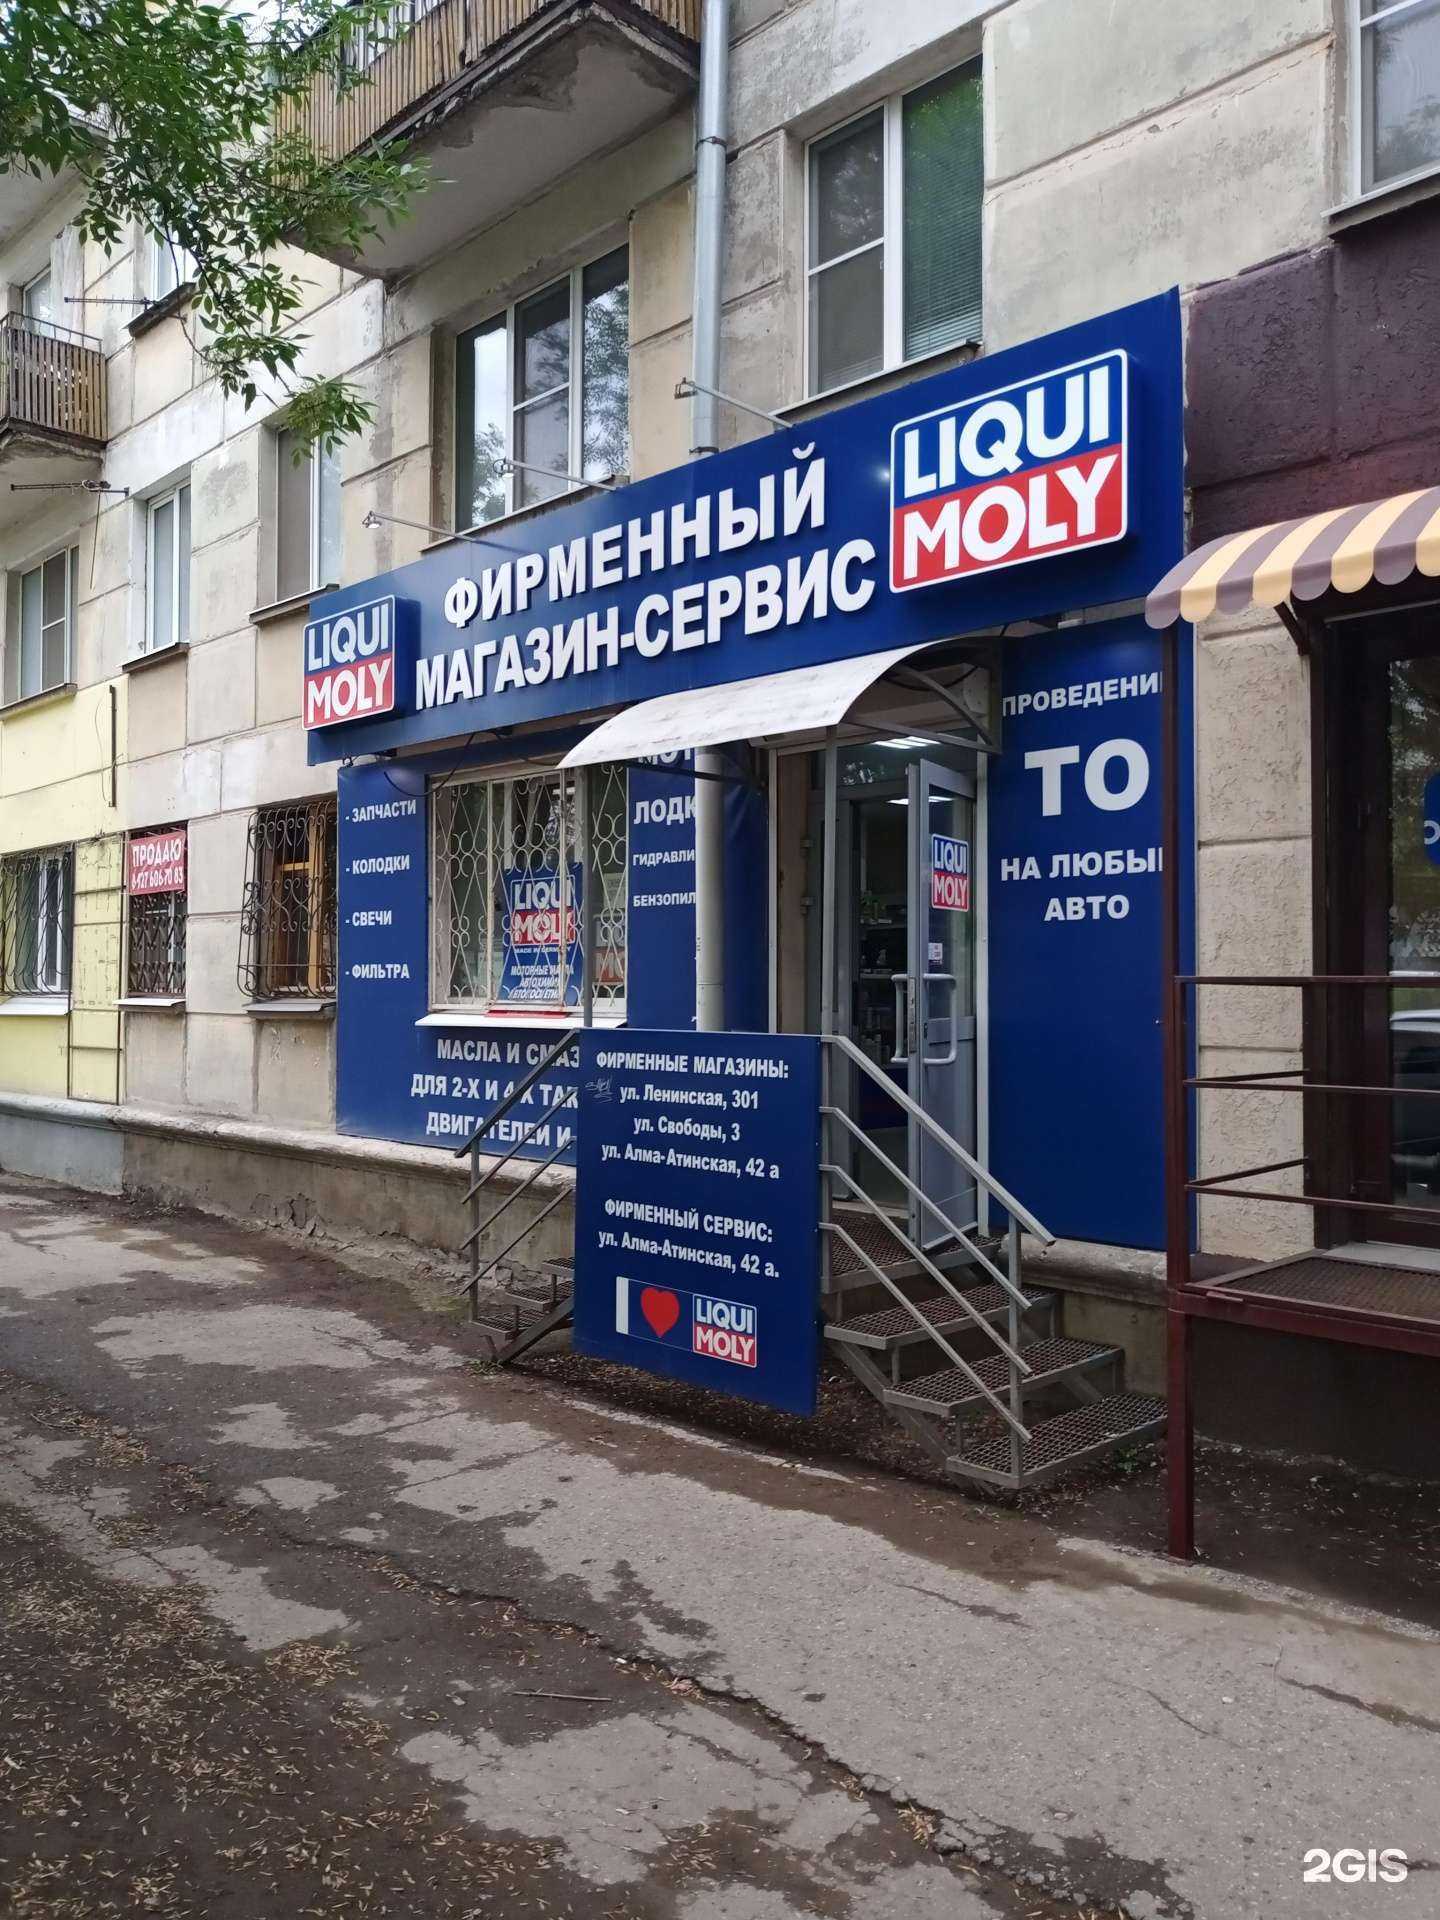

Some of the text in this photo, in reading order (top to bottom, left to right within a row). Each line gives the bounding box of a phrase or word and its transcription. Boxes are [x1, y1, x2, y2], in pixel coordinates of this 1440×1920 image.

[903, 364, 1110, 498] LIQUI
[903, 452, 1119, 580] MOLY
[443, 443, 827, 631] ФИРМЕННЫЙ
[306, 604, 391, 668] LIQUI
[415, 537, 878, 712] МАГАЗИН-СЕРВИС
[305, 656, 392, 727] MOLY
[1002, 671, 1164, 717] ПРОВЕДЕНИ
[1024, 738, 1150, 817] ТО
[351, 799, 417, 823] ЗАПЧАСТИ
[132, 839, 182, 867] ПРОДАЮ
[352, 854, 411, 875] КОЛОДКИ
[934, 839, 967, 873] LIQUI
[1000, 847, 1164, 881] НА ЛЮБЫ
[934, 875, 967, 906] MOLY
[352, 910, 393, 926] СВЕЧИ
[1043, 894, 1130, 922] АВТО
[352, 963, 410, 980] ФИЛЬТРА
[437, 1038, 501, 1063] МАСЛА
[506, 1043, 520, 1064] И
[596, 1051, 789, 1079] ФИРМЕННЫЕ МАГАЗИНЫ:
[410, 1073, 447, 1098] ДЛЯ
[485, 1079, 498, 1100] И
[619, 1086, 640, 1103] ул.
[643, 1084, 727, 1110] Ленинская,
[731, 1089, 759, 1109] 301
[633, 1116, 741, 1143] ул. Свободы, 3
[601, 1144, 622, 1161] ул.
[624, 1142, 741, 1177] Алма-Атинская,
[745, 1157, 765, 1177] 42
[604, 1198, 773, 1243] ФИРМЕННЫЙ СЕРВИС:
[598, 1230, 780, 1278] ул. Алма-Атинская, 42 а.
[696, 1298, 753, 1334] LIQUI
[696, 1326, 755, 1362] MOLY
